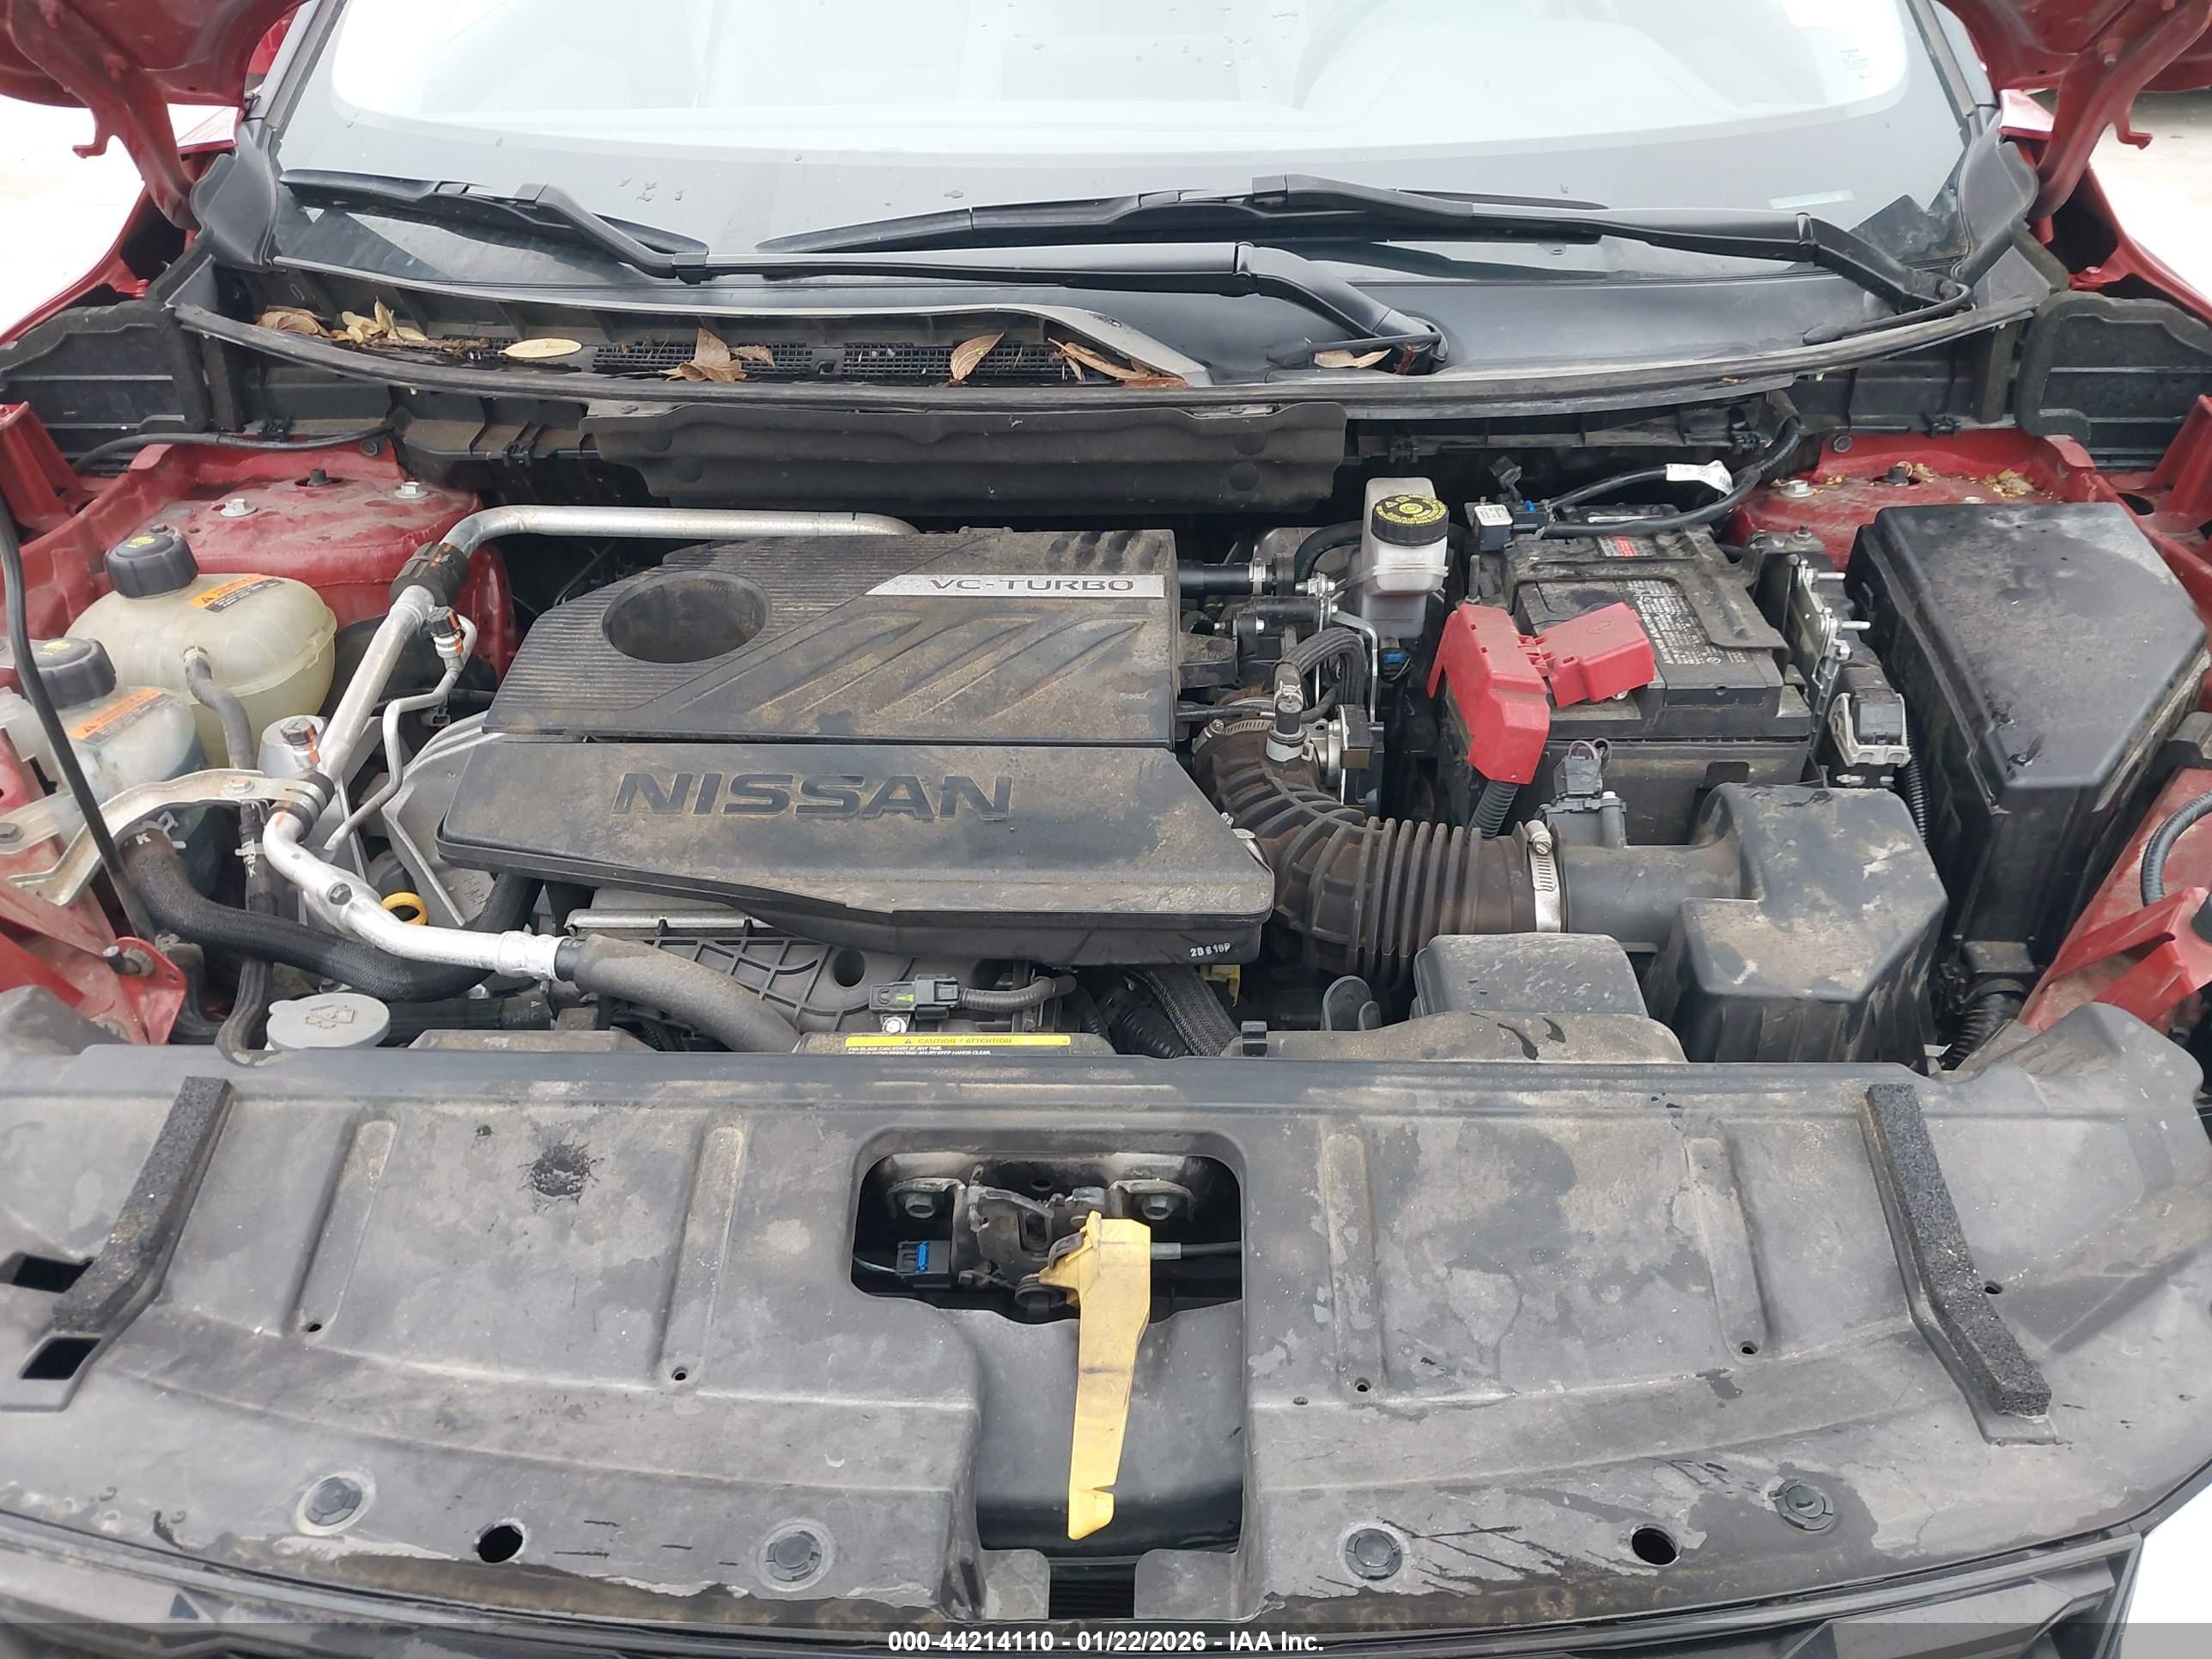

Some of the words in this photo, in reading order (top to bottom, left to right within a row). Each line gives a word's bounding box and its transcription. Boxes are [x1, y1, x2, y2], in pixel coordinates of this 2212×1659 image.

[929, 578, 1135, 592] VC-TURBO
[611, 771, 1014, 823] NISSAN
[135, 832, 152, 846] K
